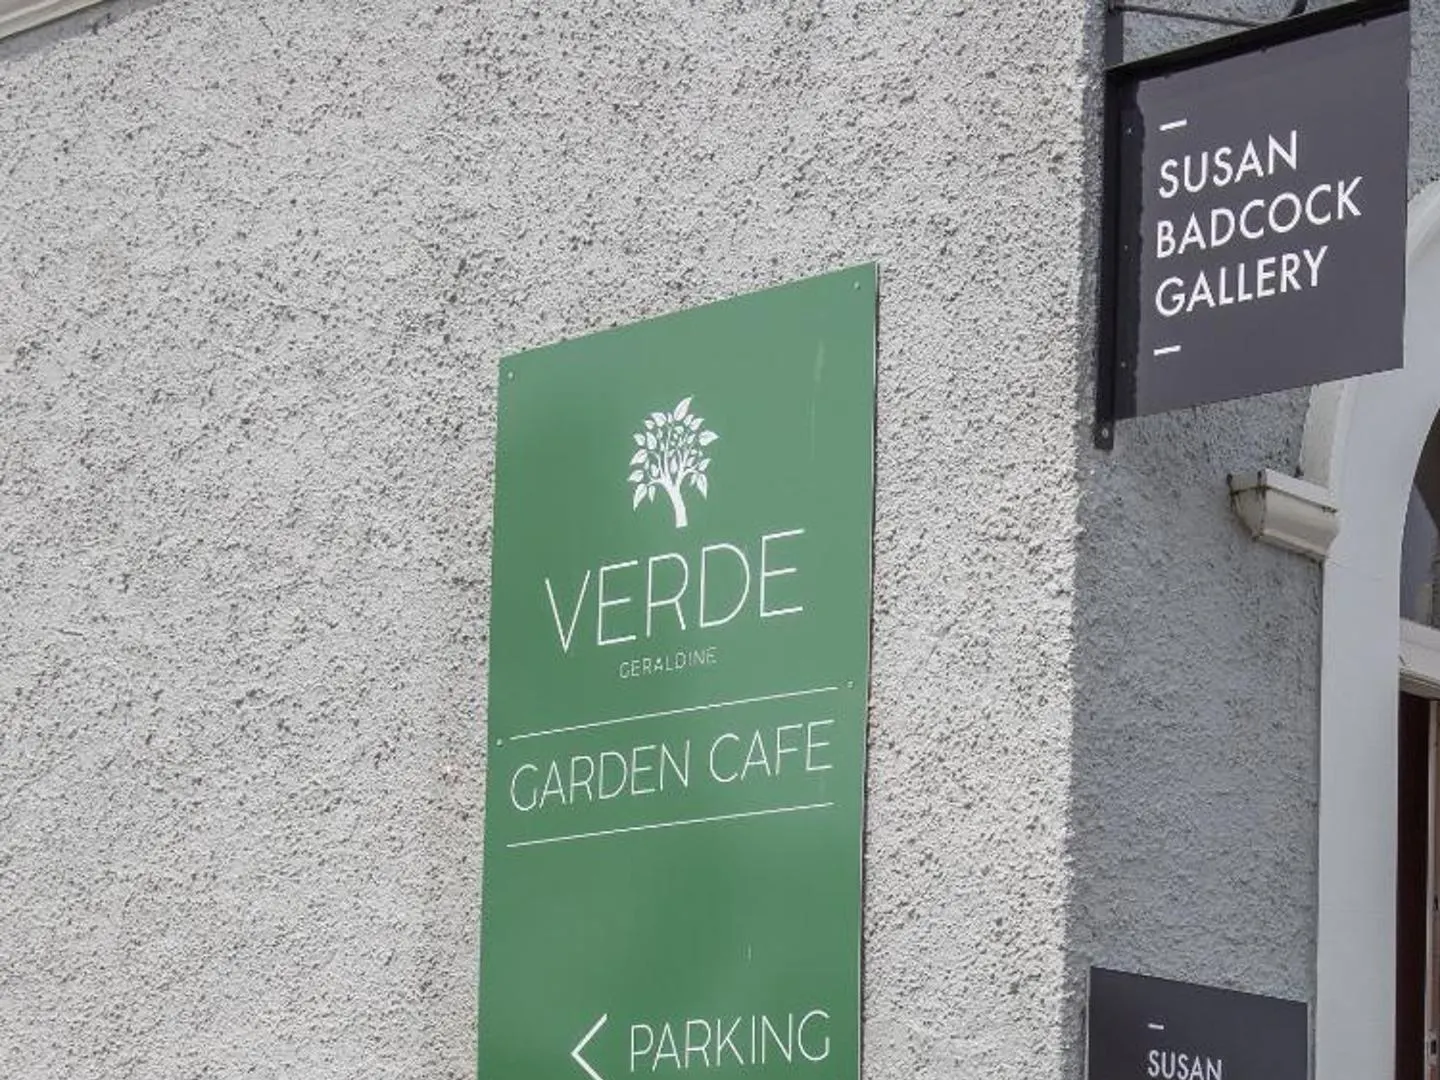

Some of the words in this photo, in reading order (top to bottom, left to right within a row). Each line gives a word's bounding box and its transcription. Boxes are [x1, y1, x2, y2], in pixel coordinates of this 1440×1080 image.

[1158, 130, 1299, 199] SUSAN
[1156, 175, 1363, 259] BADCOCK
[1155, 245, 1328, 317] GALLERY
[545, 528, 805, 654] VERDE
[618, 646, 718, 679] GERALDINE
[510, 740, 691, 812] GARDEN
[709, 720, 834, 783] CAFE
[629, 1009, 831, 1072] PARKING
